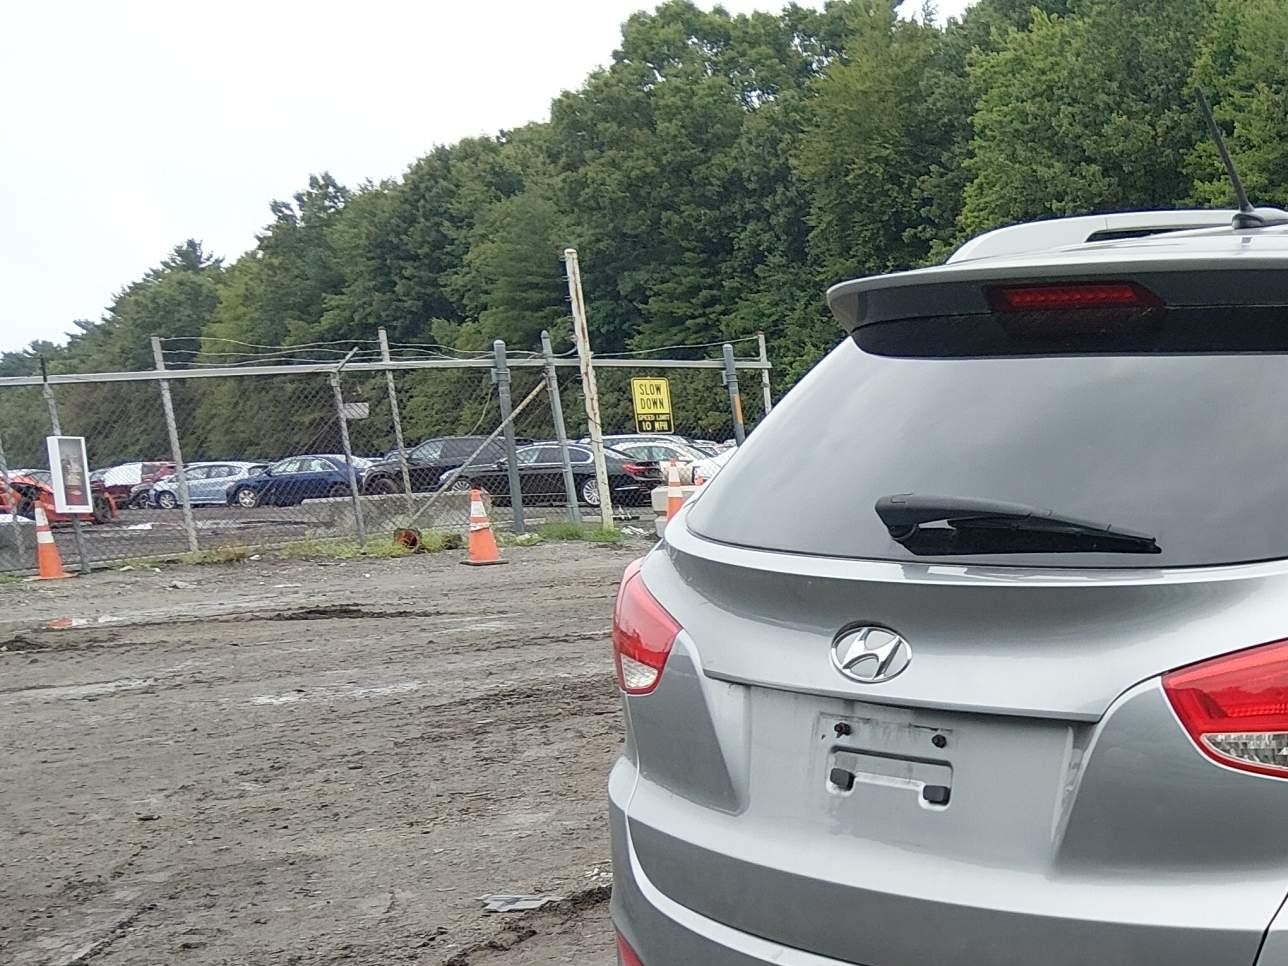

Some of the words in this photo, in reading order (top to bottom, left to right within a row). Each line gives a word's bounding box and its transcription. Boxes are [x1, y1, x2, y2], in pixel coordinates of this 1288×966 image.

[639, 383, 662, 396] SLOW
[640, 397, 665, 410] DOWN
[642, 421, 652, 431] 10
